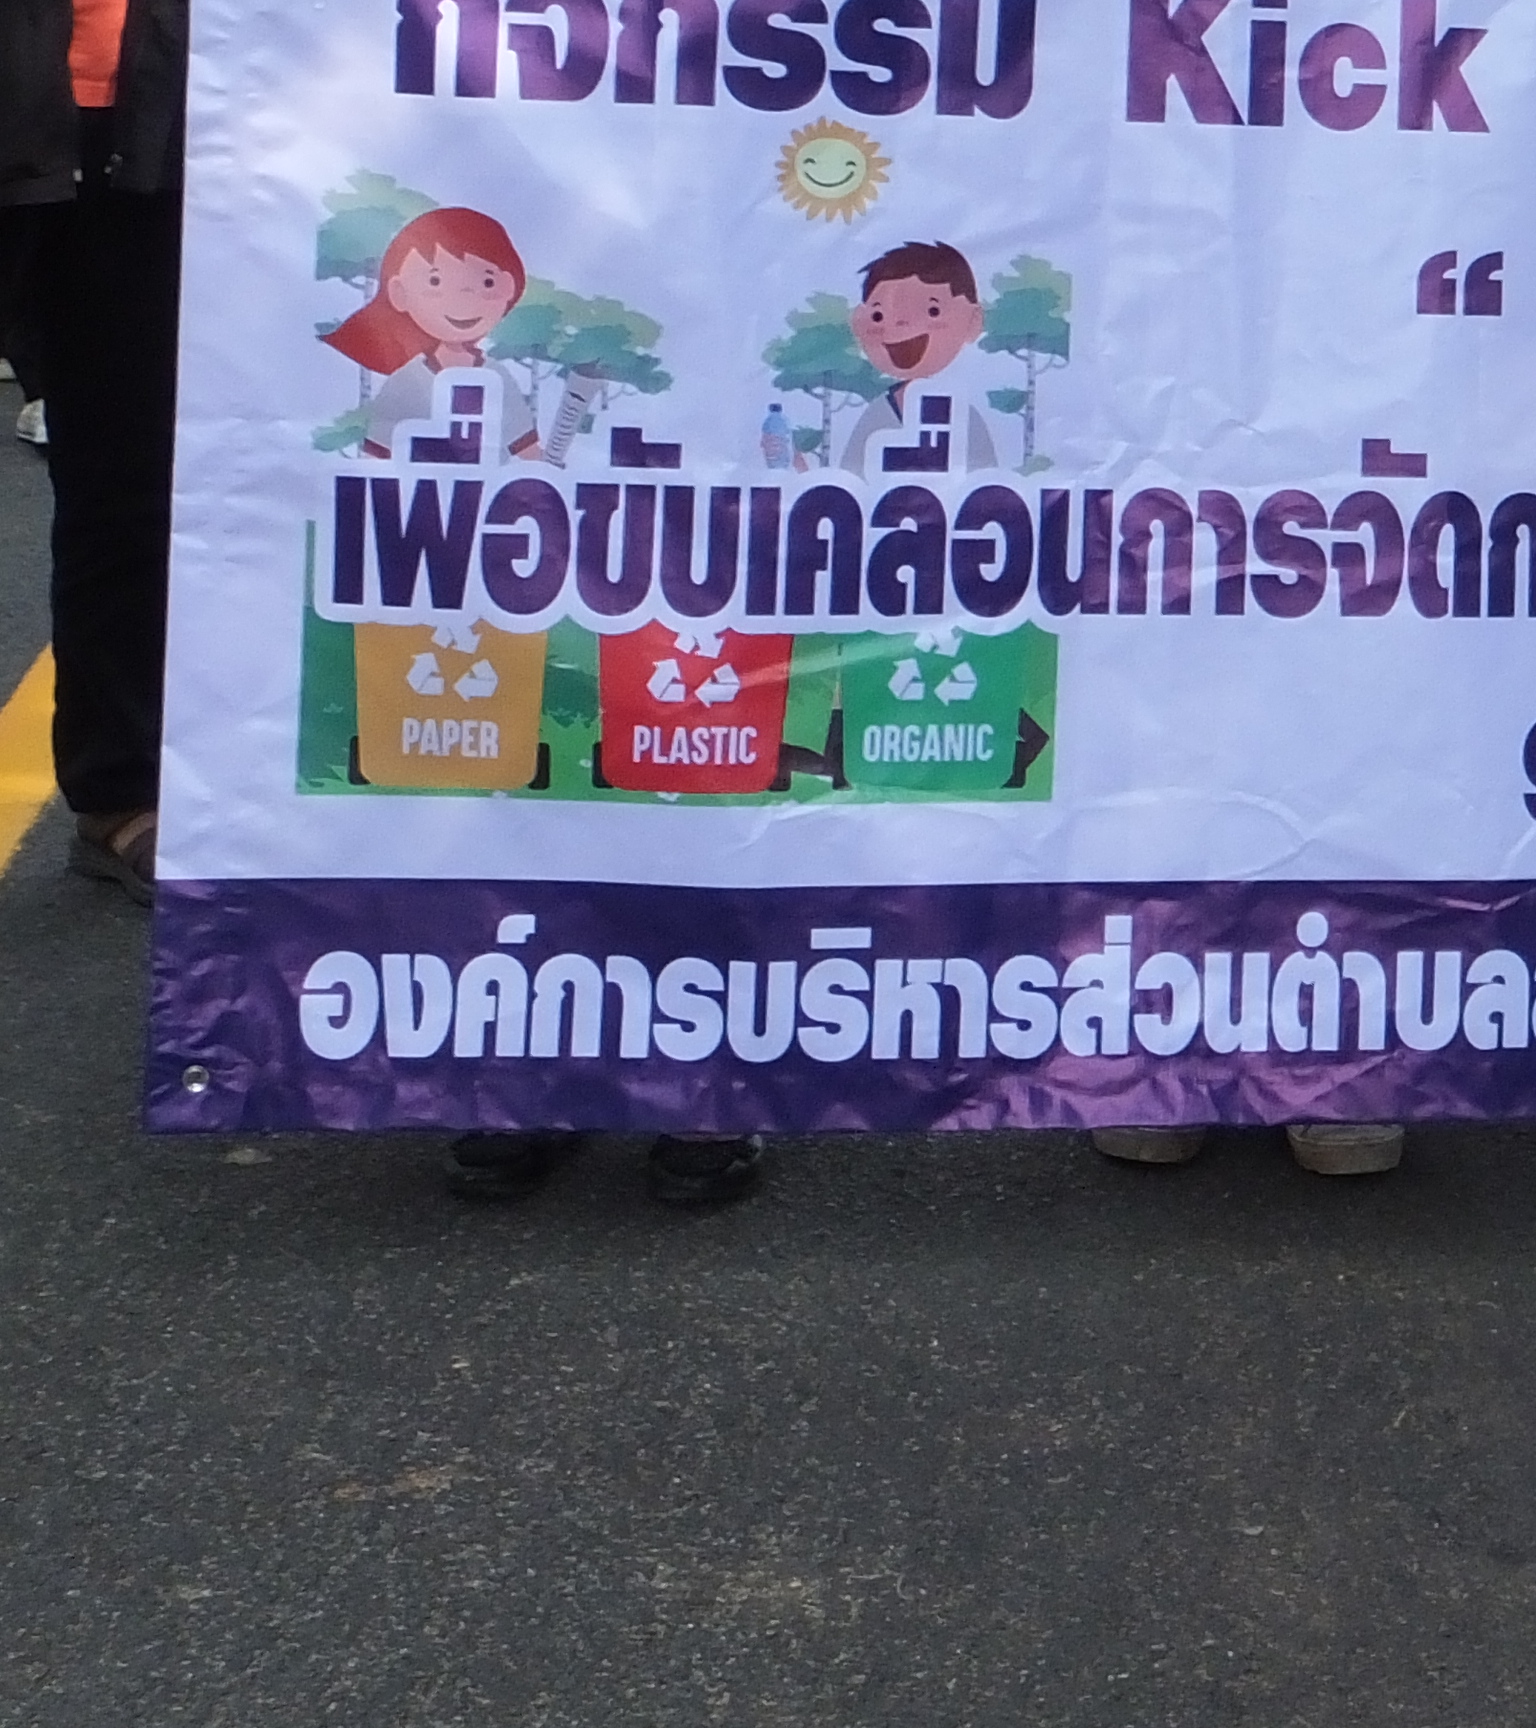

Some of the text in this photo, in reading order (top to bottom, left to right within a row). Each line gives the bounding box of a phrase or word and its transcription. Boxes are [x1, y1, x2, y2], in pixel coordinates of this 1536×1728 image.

[401, 715, 500, 760] PAPER
[631, 723, 758, 767] PLASTIC
[862, 720, 995, 764] ORGANIC
